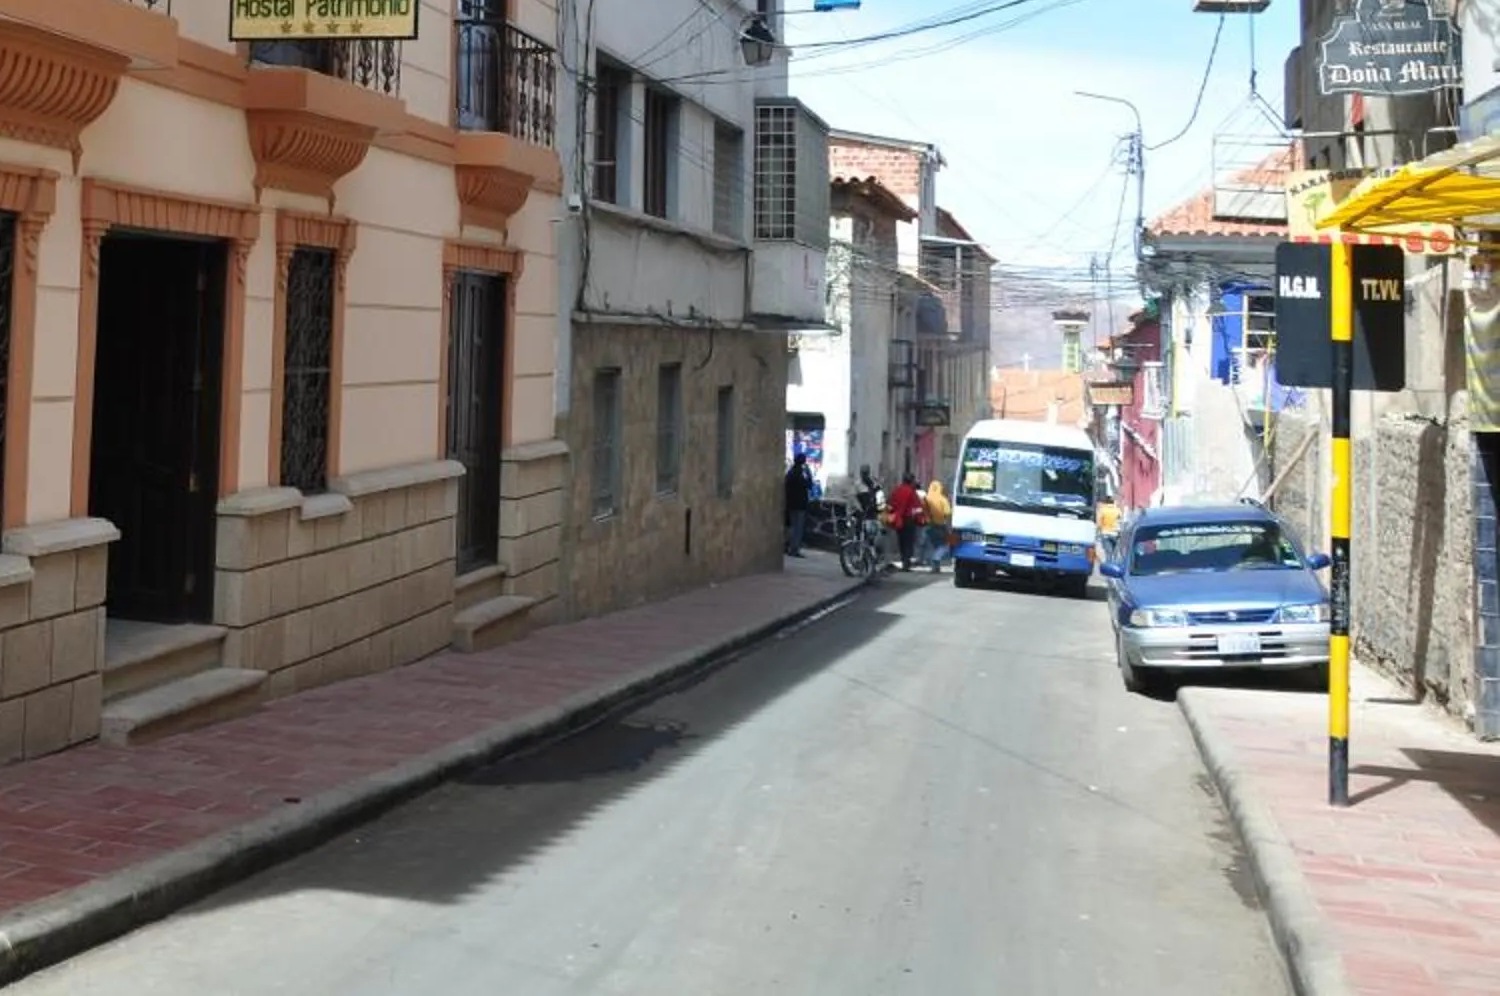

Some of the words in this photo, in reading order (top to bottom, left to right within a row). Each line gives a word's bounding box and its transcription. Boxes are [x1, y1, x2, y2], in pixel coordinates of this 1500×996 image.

[1349, 39, 1448, 57] Restaurante
[1329, 61, 1392, 84] Doña
[1400, 60, 1463, 83] Mari
